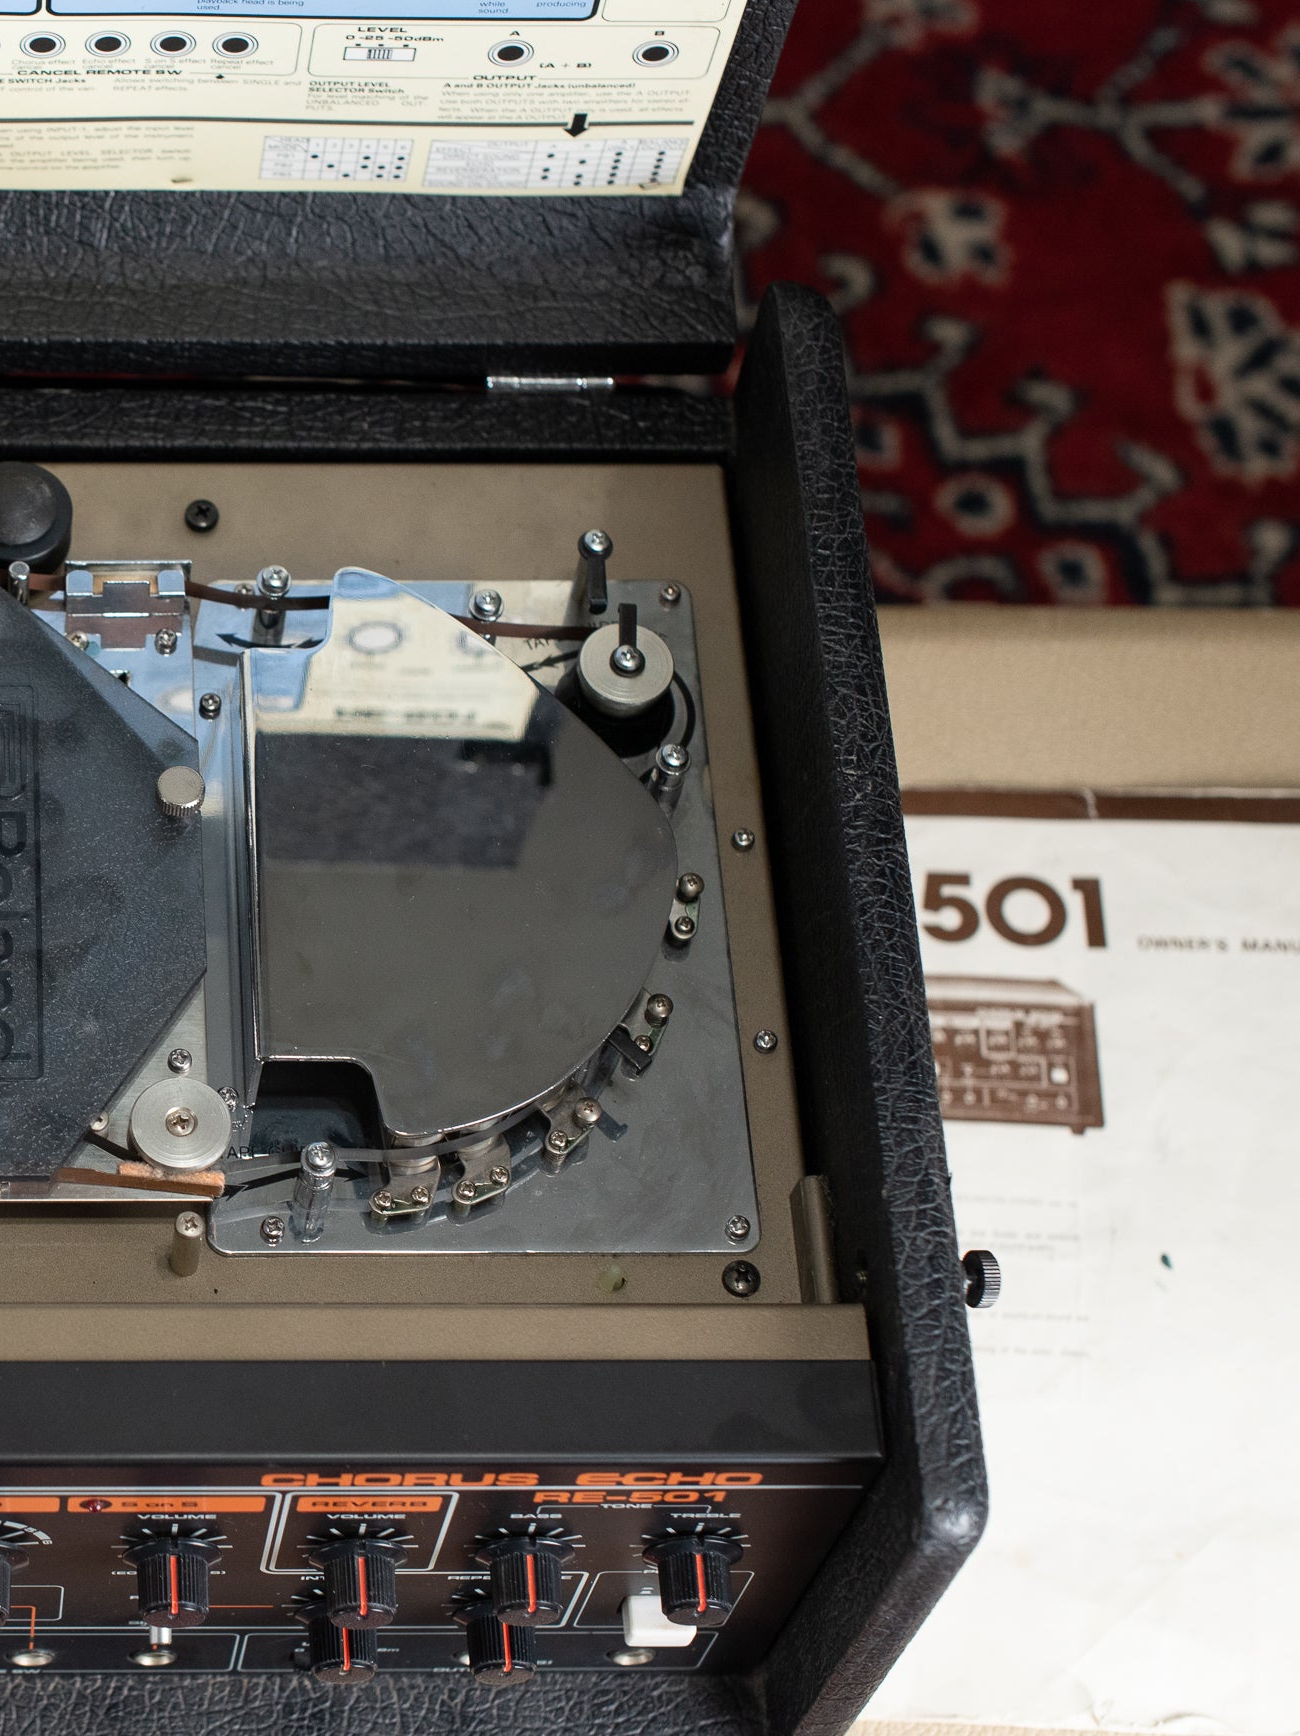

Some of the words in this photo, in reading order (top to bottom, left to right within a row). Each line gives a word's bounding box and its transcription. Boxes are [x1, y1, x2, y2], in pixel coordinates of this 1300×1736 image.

[922, 870, 1108, 951] 501
[1241, 936, 1300, 953] MANU
[261, 1472, 539, 1487] CHORUS
[576, 1472, 764, 1486] ECHO
[312, 1500, 428, 1508] REVERB
[533, 1491, 728, 1504] RE-501
